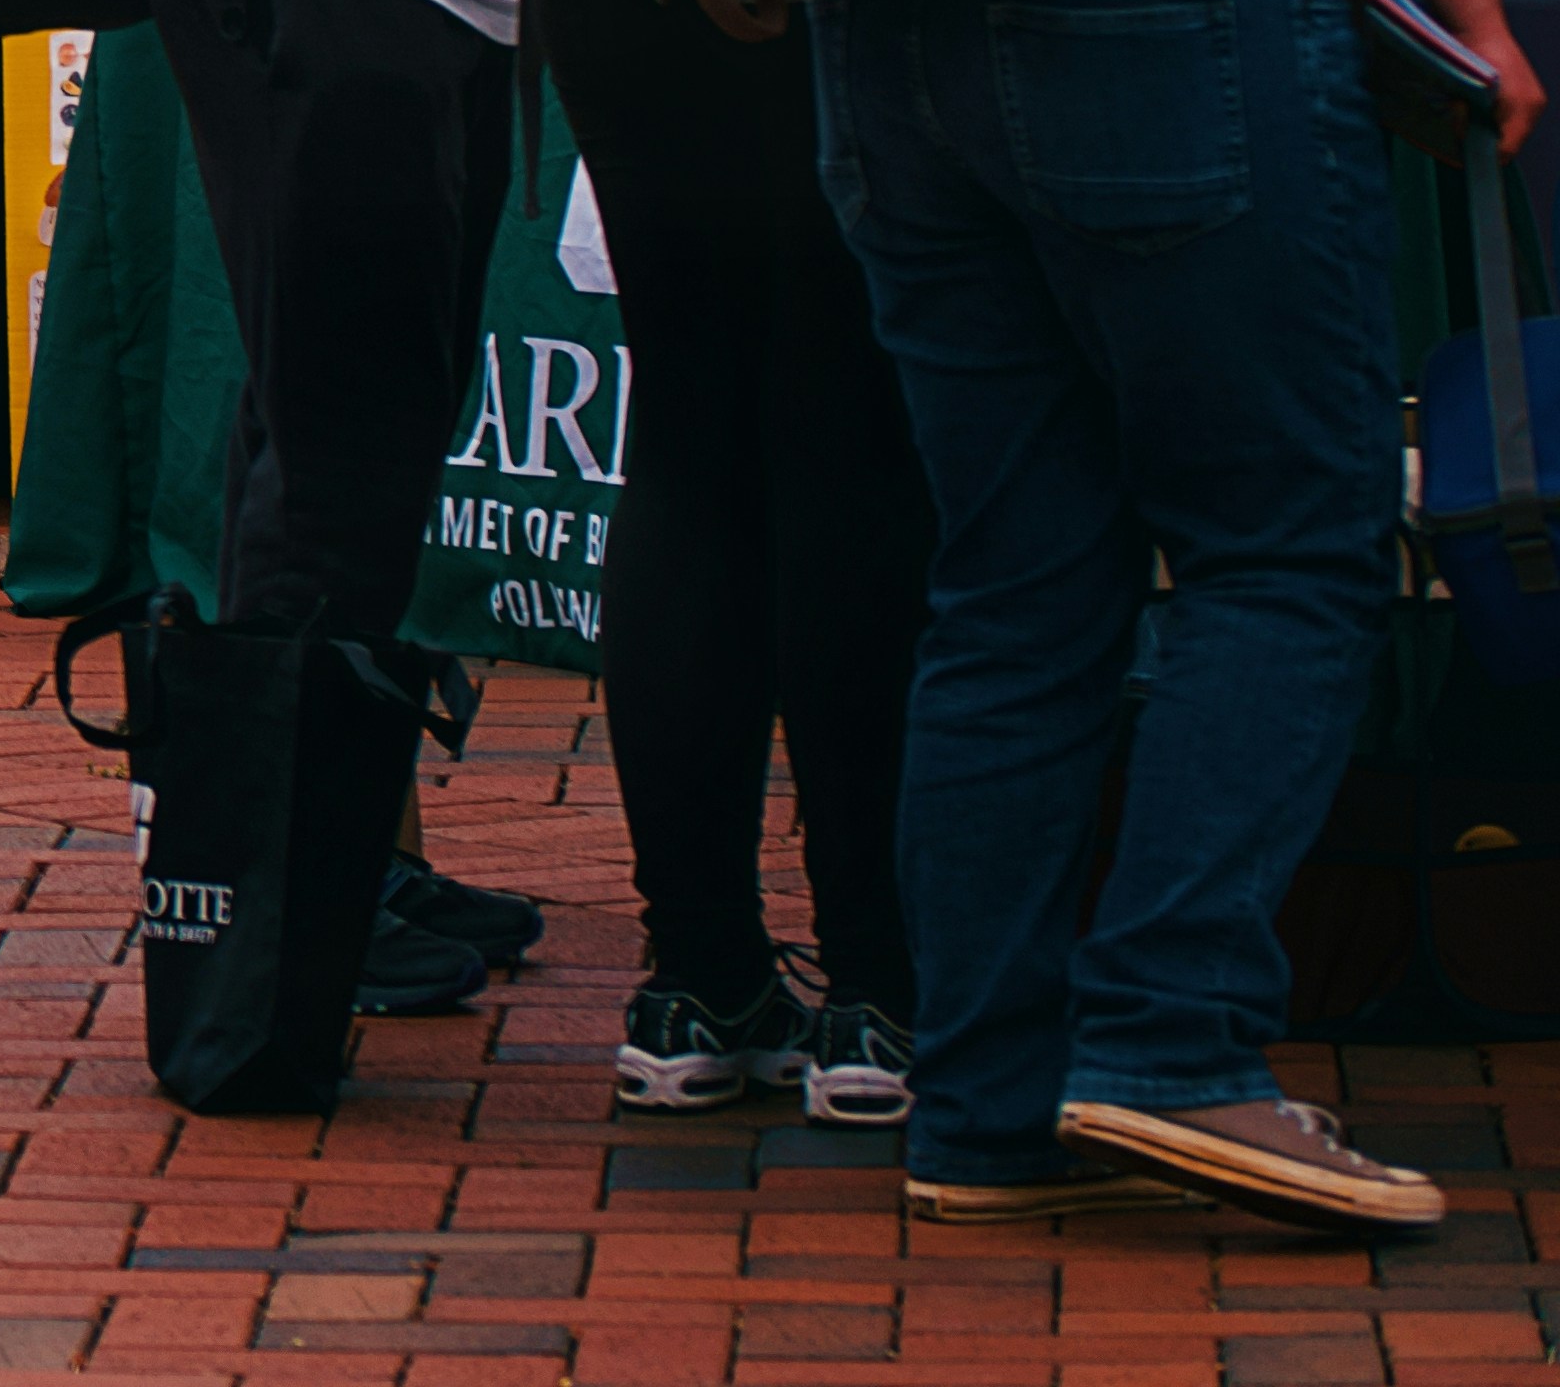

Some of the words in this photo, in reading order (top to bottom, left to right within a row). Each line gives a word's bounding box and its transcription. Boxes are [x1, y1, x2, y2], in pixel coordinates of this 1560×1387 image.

[422, 495, 514, 556] MET
[523, 507, 576, 562] OF
[143, 878, 233, 925] OTTE
